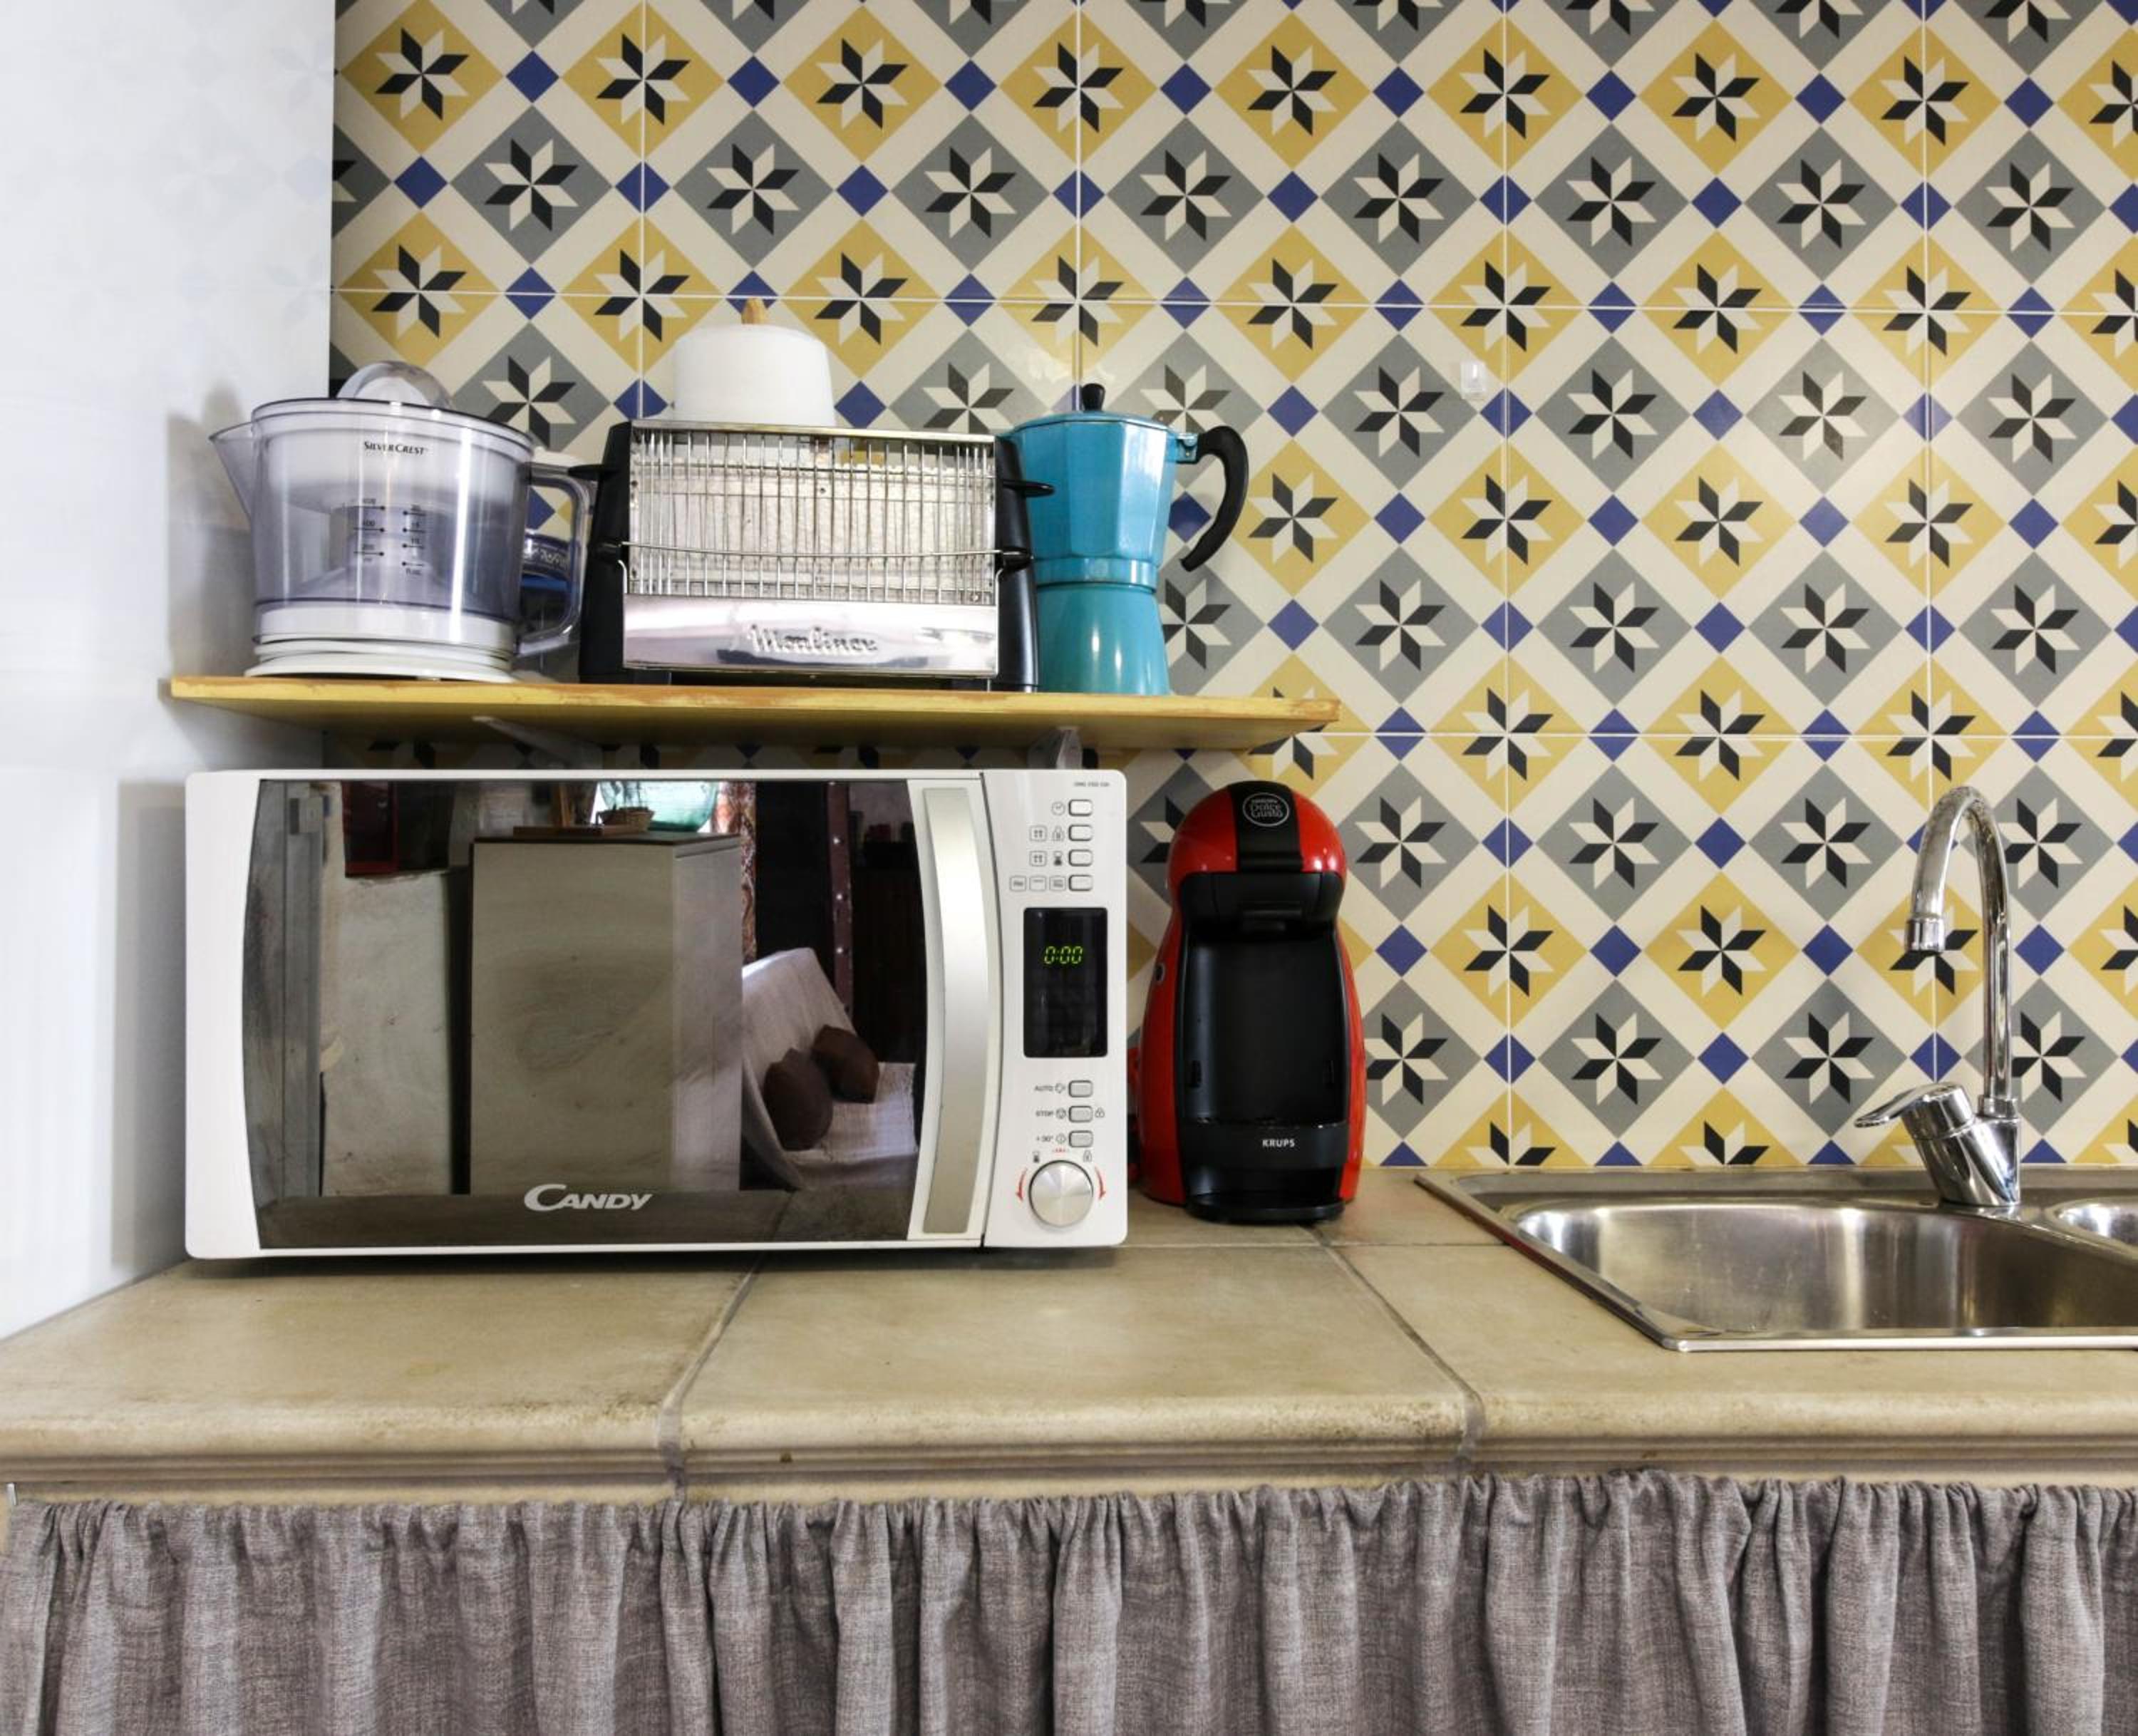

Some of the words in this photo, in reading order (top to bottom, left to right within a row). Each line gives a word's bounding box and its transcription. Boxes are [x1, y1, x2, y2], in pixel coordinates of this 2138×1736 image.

[1044, 946, 1083, 964] 0:00
[1262, 1138, 1295, 1147] KRUPS
[524, 1183, 654, 1211] CANDY
